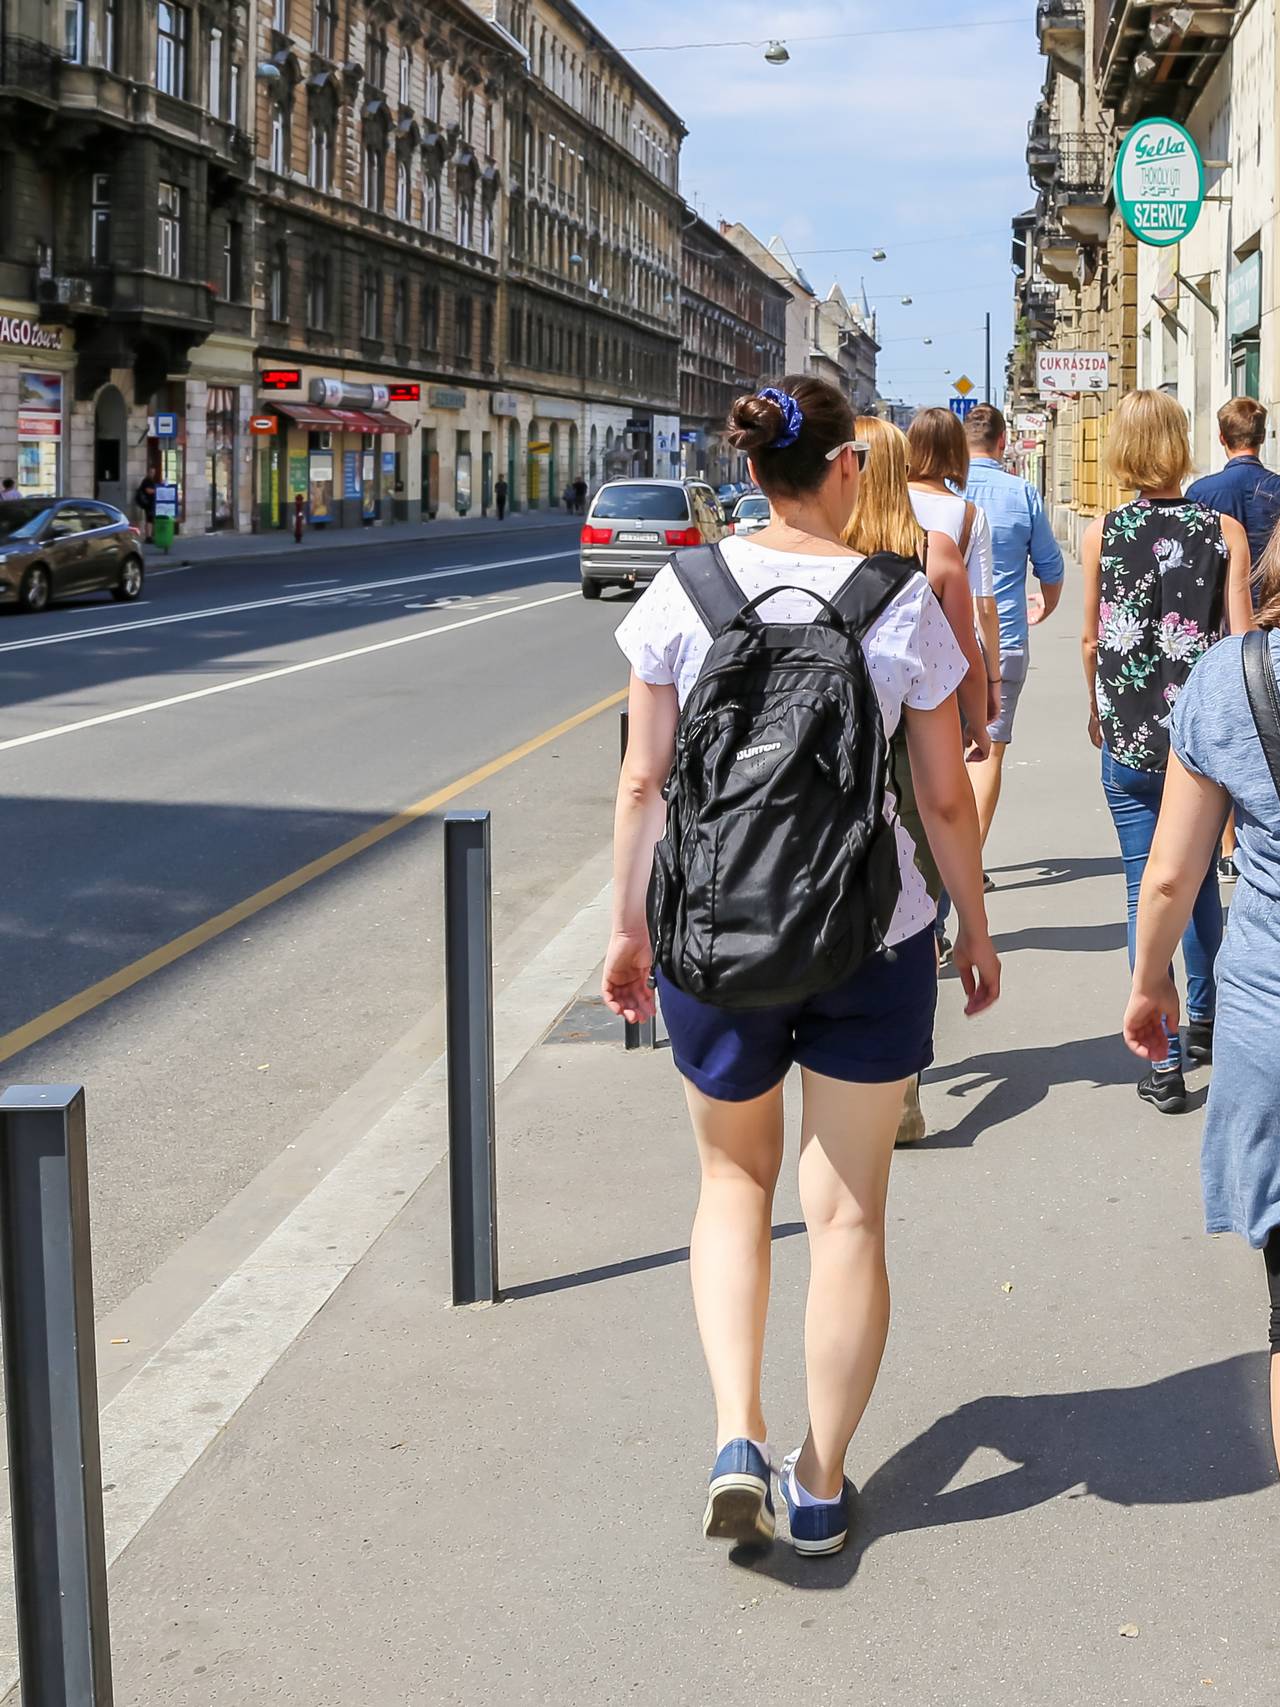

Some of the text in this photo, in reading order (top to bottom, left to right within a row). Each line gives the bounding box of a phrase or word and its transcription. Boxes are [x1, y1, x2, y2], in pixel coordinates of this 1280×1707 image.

[1135, 133, 1186, 159] Gelka
[1140, 186, 1180, 197] KFT
[1134, 203, 1187, 228] SZERVIZ
[0, 316, 31, 345] AGO
[1040, 353, 1106, 370] CUKRÁSZDA
[736, 742, 781, 761] BURTON
